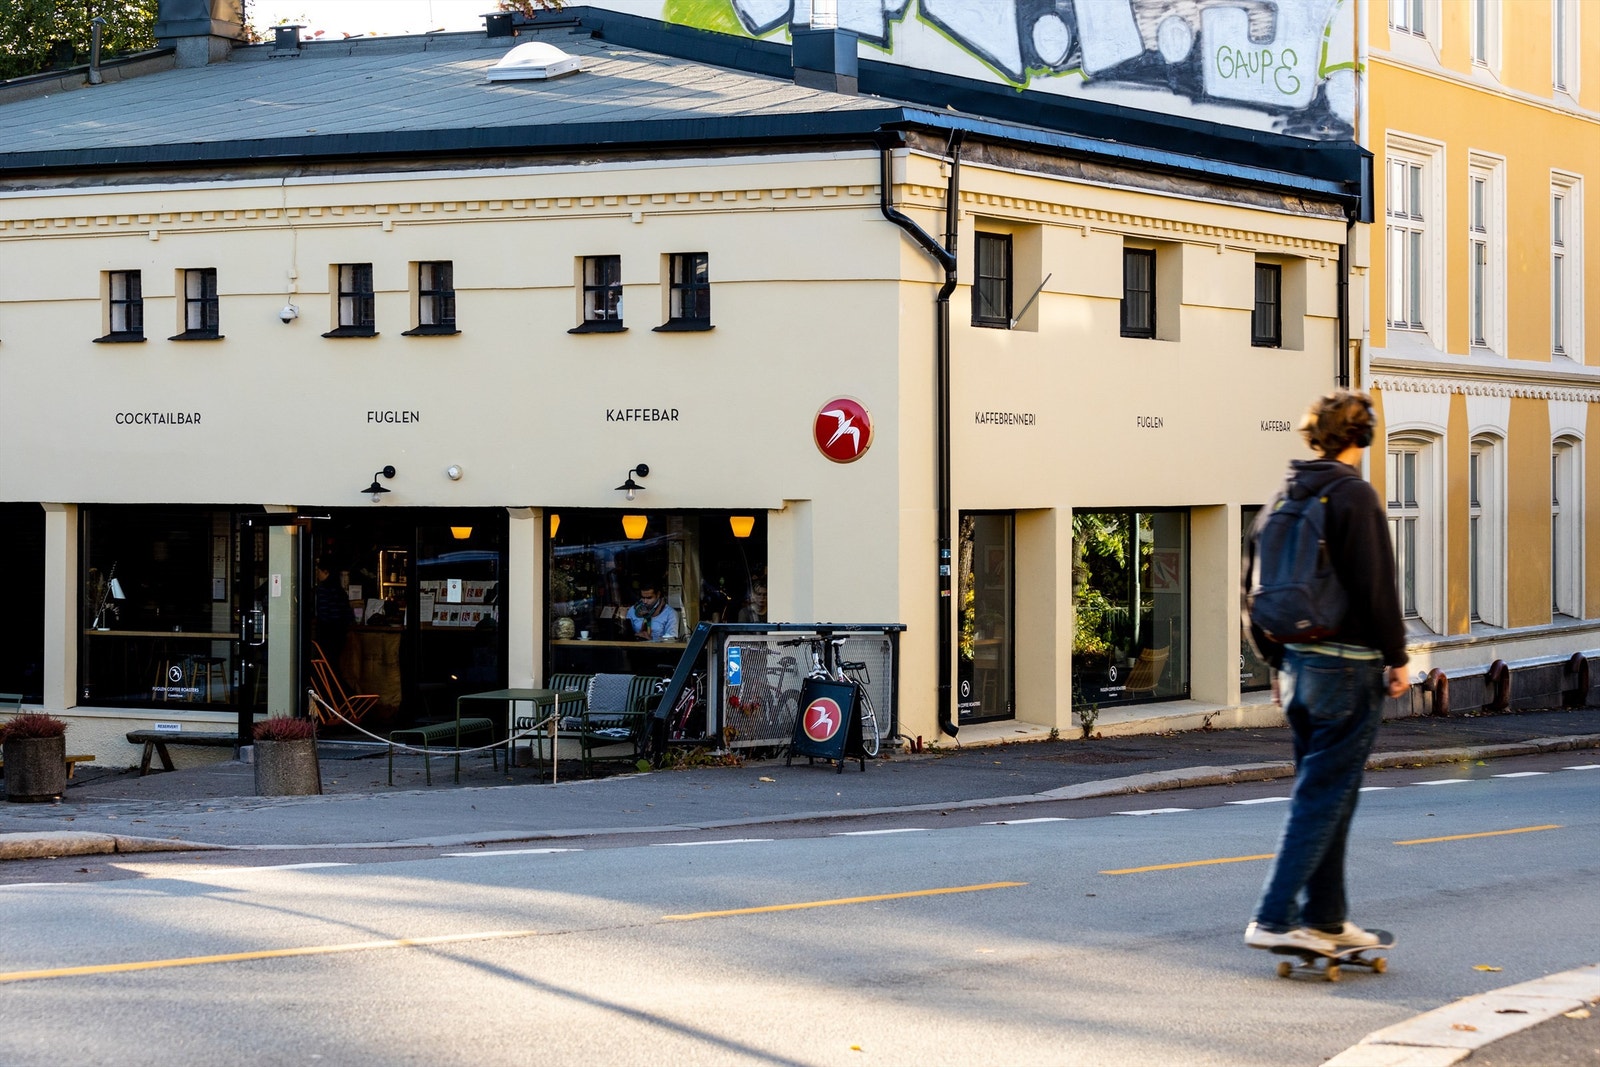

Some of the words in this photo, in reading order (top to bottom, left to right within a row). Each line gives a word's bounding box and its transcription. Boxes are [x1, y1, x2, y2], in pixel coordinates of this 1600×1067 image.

[115, 412, 202, 425] COCKTAILBAR
[367, 410, 420, 424] FUGLEN
[606, 408, 679, 422] KAFFEBAR
[975, 411, 1036, 426] KAFFEBRENNERI
[1136, 415, 1164, 429] FUGLEN
[1260, 420, 1291, 432] KAFFEBAR
